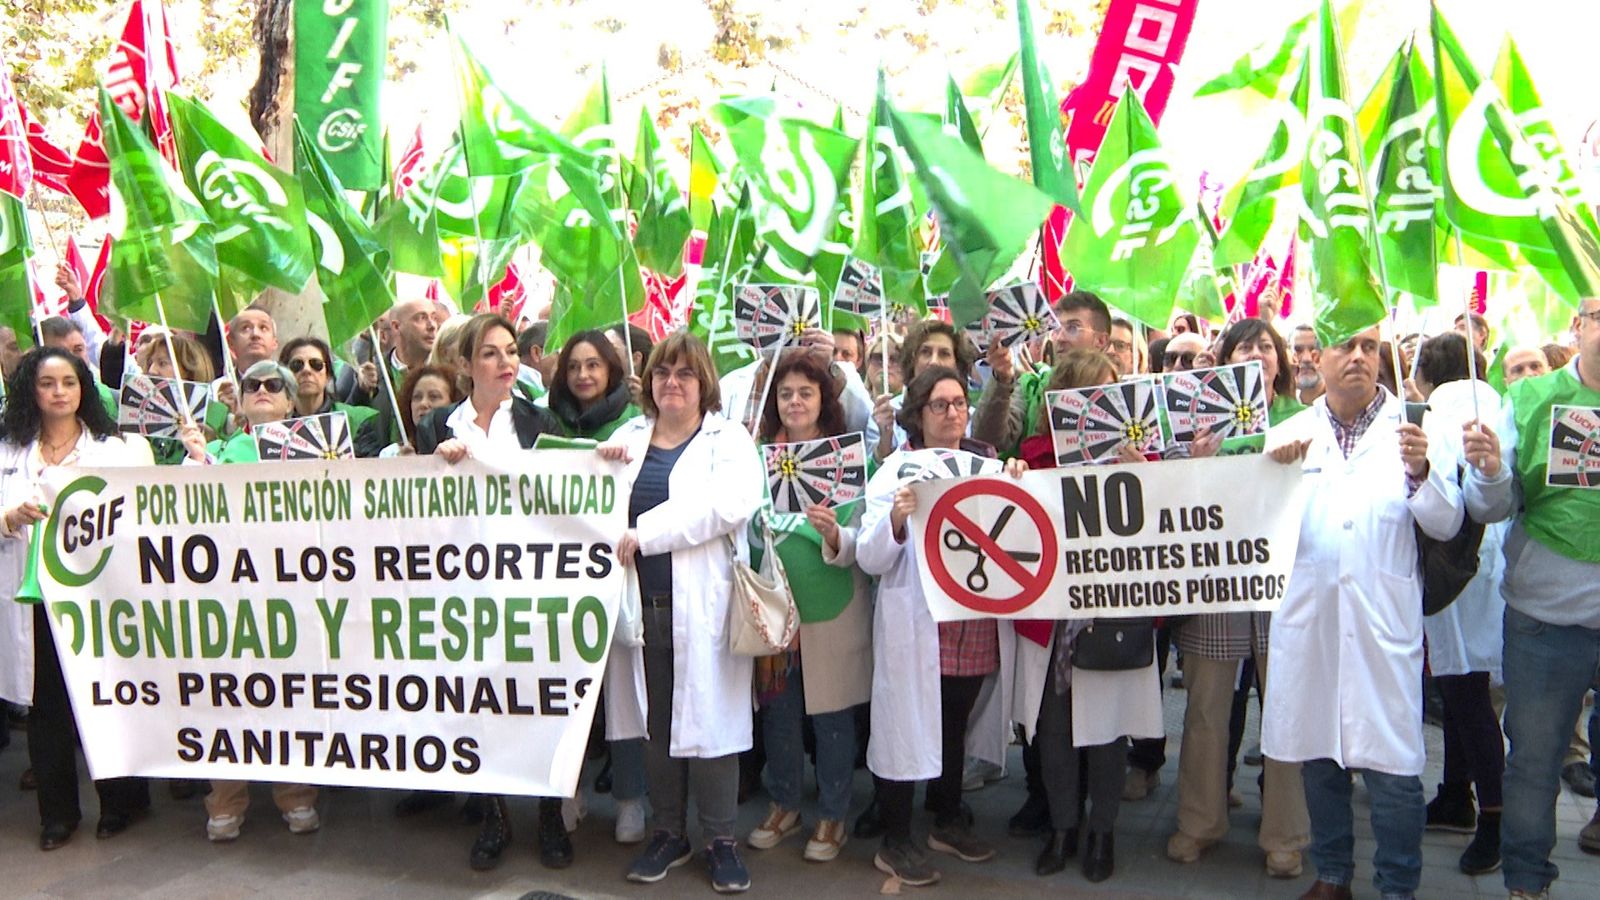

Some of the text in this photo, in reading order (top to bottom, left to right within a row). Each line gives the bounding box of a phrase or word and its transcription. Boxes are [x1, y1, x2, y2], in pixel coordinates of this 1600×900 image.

[1110, 168, 1176, 262] CSIF
[1175, 376, 1221, 401] LUCHMOS
[1060, 394, 1109, 421] LUCHMOS
[1179, 415, 1217, 426] NUSTRO
[1237, 406, 1251, 421] 35
[265, 426, 309, 450] LUCHMOS
[1065, 432, 1108, 446] NUSTRO
[1127, 425, 1144, 440] 35
[815, 452, 855, 467] NUSTRO
[137, 470, 616, 526] POR UNA ATENCIÓN SANITARIA DE CALIDAD
[1061, 471, 1224, 540] NO A LOS
[138, 535, 614, 585] NO A LOS RECORTES
[1065, 537, 1270, 575] RECORTES EN LOS
[1067, 573, 1286, 611] SERVICIOS PÚBLICOS
[315, 597, 350, 660] Y
[373, 594, 610, 664] RESPETO
[177, 727, 482, 775] SANITARIOS
